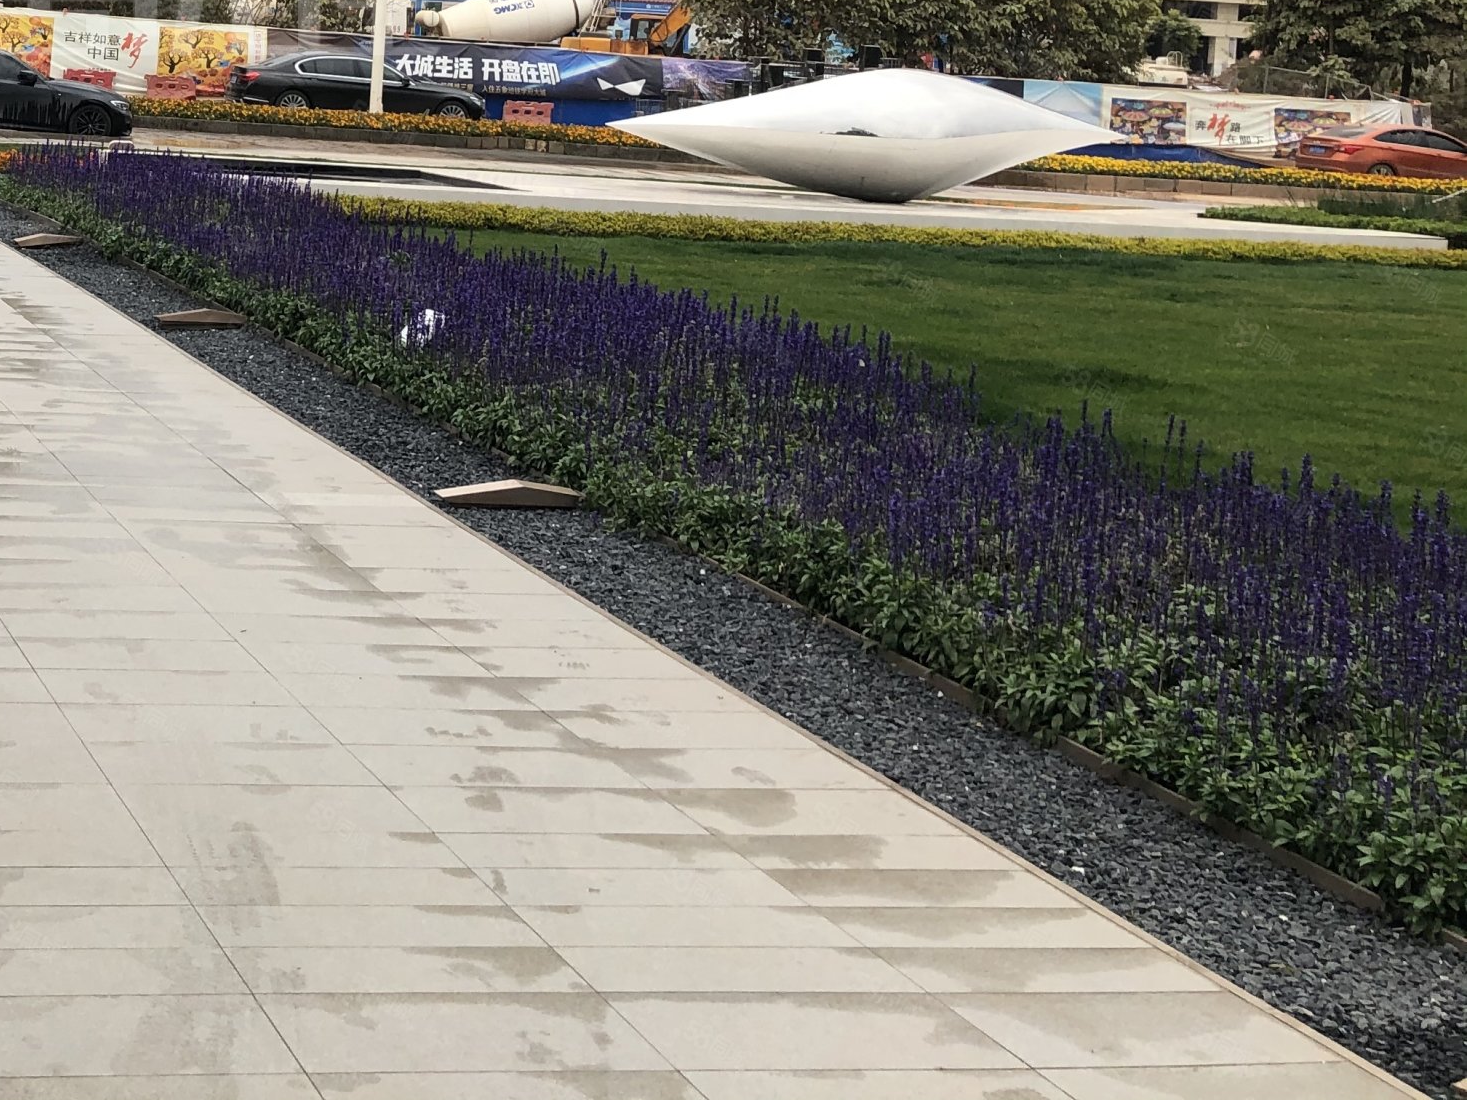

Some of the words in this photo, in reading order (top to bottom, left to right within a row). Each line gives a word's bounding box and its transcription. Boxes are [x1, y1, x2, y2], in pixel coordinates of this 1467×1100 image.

[63, 30, 122, 46] 吉祥如意
[87, 45, 120, 62] 中国
[394, 53, 474, 80] 大城生活
[480, 58, 561, 85] 开盘在即
